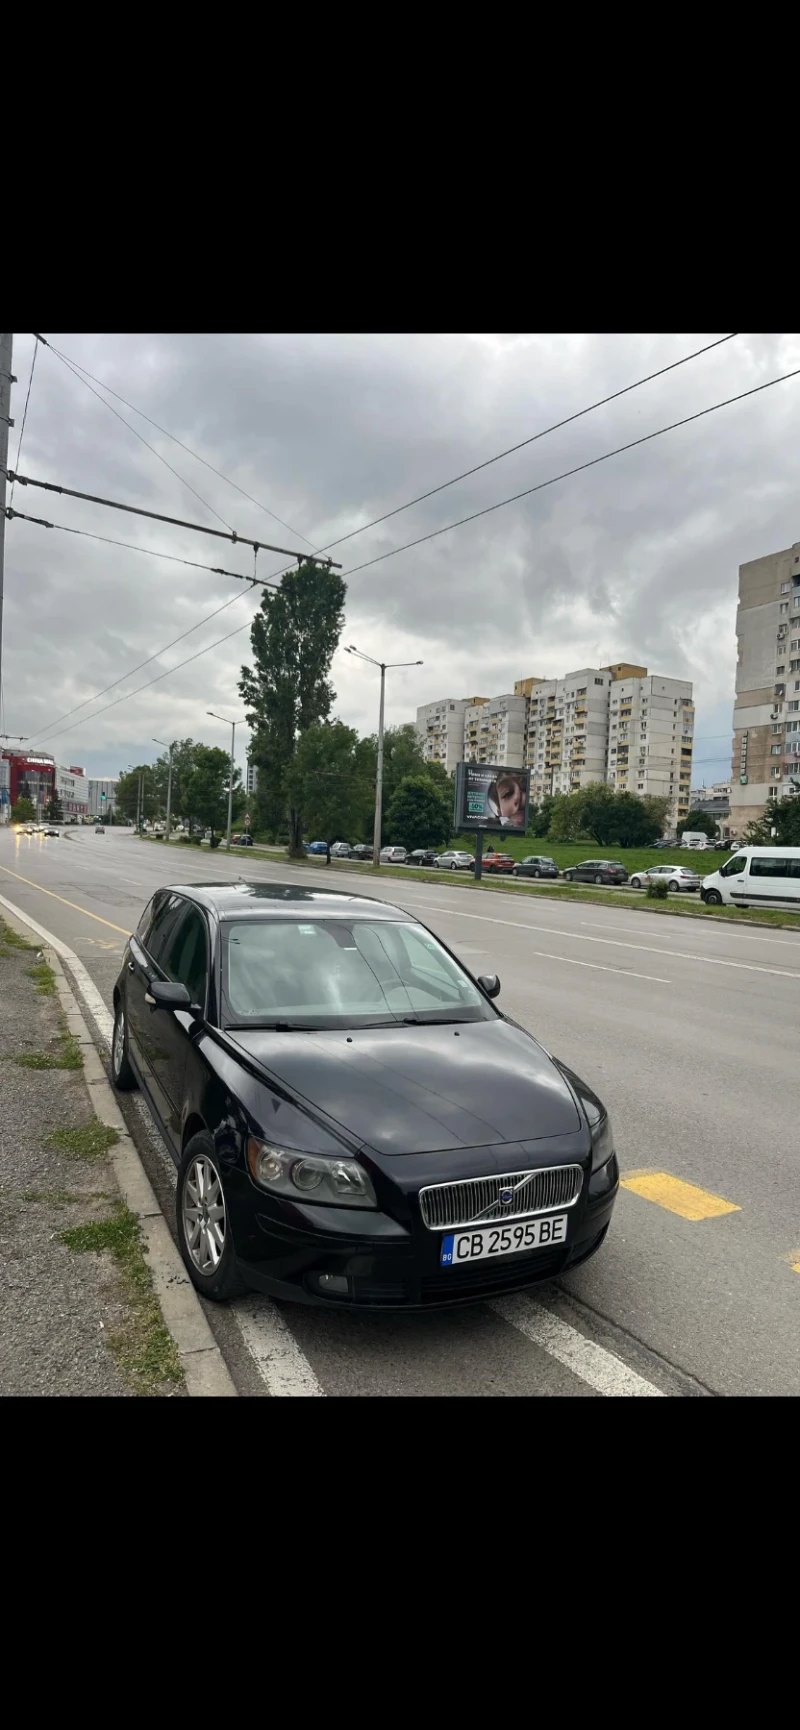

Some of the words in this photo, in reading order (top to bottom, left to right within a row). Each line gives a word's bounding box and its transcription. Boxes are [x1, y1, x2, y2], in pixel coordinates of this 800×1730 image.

[457, 1233, 483, 1259] CB
[488, 1224, 535, 1253] 2595
[539, 1218, 564, 1243] BE
